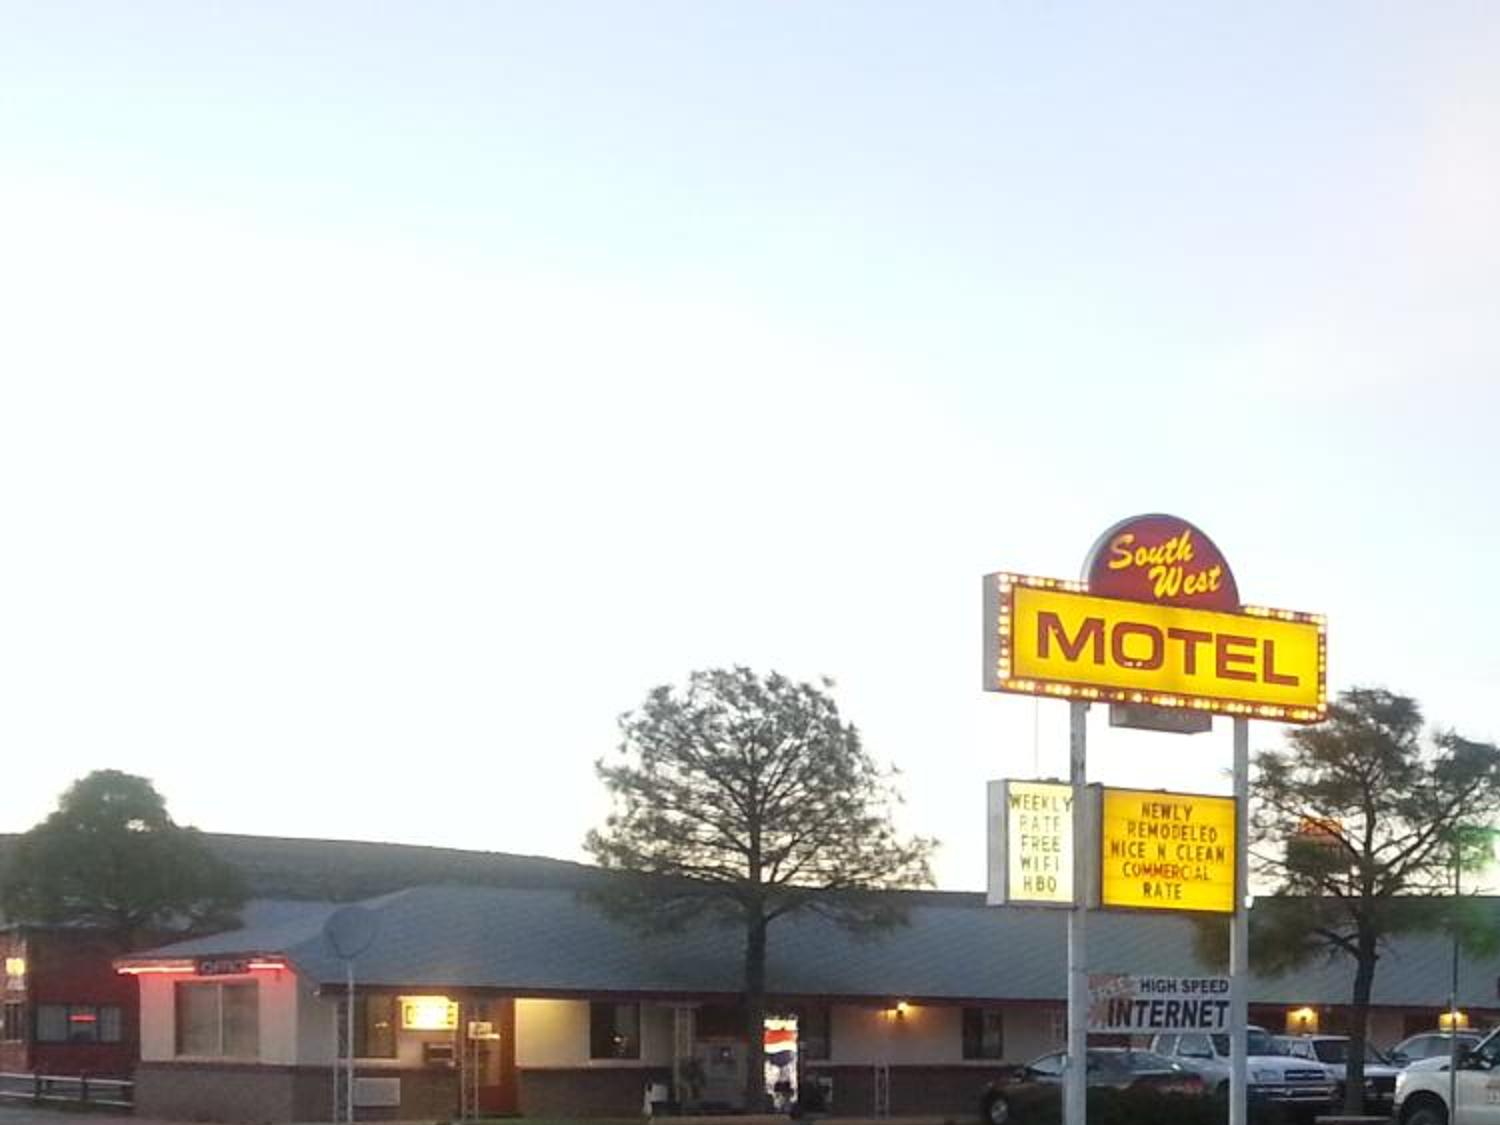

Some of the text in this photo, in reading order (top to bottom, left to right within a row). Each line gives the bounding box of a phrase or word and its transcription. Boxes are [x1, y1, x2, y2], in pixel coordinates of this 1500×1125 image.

[1108, 529, 1194, 570] South
[1149, 564, 1222, 598] West
[1036, 611, 1299, 686] MOTEL
[1008, 793, 1073, 812] WEEKLY
[1142, 803, 1192, 821] NEWLY
[1020, 814, 1061, 832] RATE
[1127, 821, 1218, 843] REMODELED
[1021, 834, 1061, 852] FREE
[1111, 840, 1225, 864] NICE N CLEAN
[1020, 854, 1059, 872] WIFI
[1023, 875, 1057, 892] HBO
[1143, 882, 1183, 900] RATE
[1140, 979, 1177, 993] HIGH
[1182, 979, 1230, 993] SPEED
[1107, 998, 1230, 1028] INTERNET
